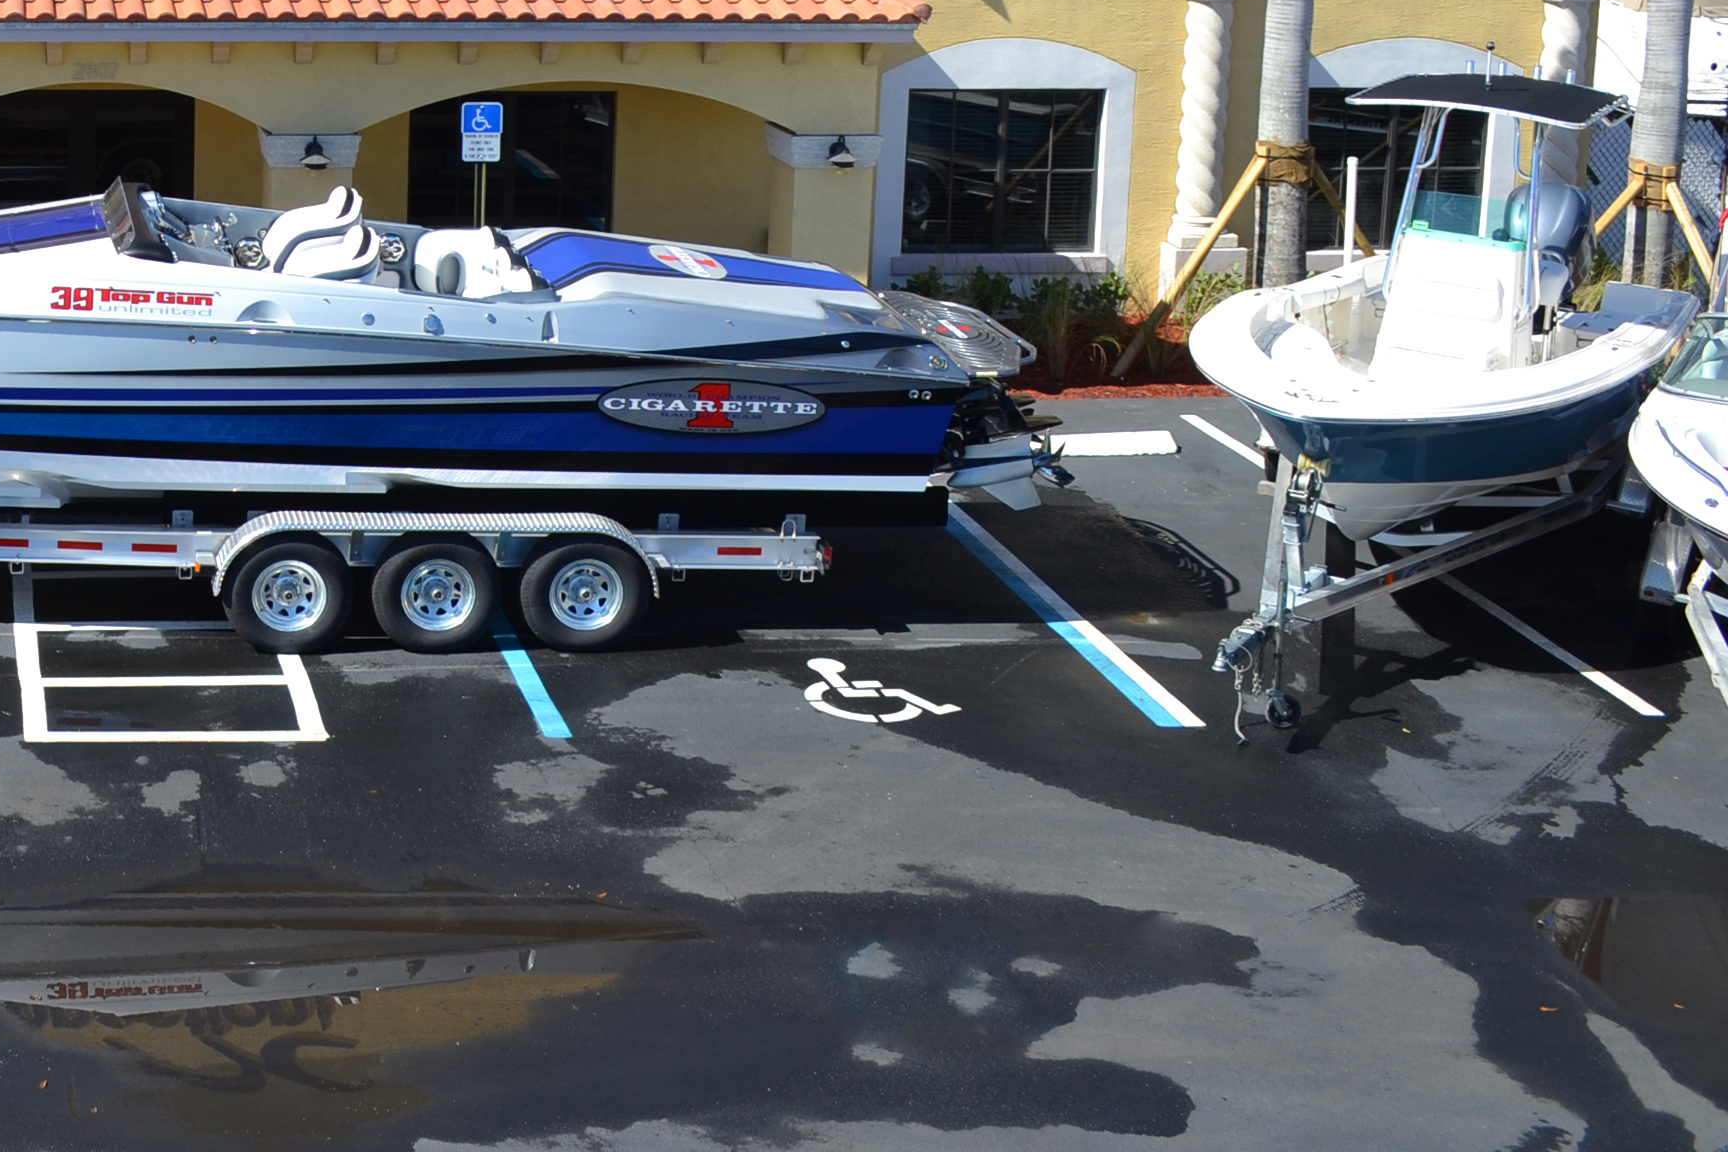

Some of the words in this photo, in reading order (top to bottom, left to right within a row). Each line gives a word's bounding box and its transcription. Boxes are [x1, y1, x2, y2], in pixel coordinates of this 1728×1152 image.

[50, 286, 94, 311] 39
[95, 287, 155, 304] Top
[156, 291, 214, 307] Gun
[98, 304, 212, 317] unlimited
[706, 393, 782, 401] CHAMPION
[603, 397, 817, 415] CIGARETTE
[660, 411, 714, 419] RACING
